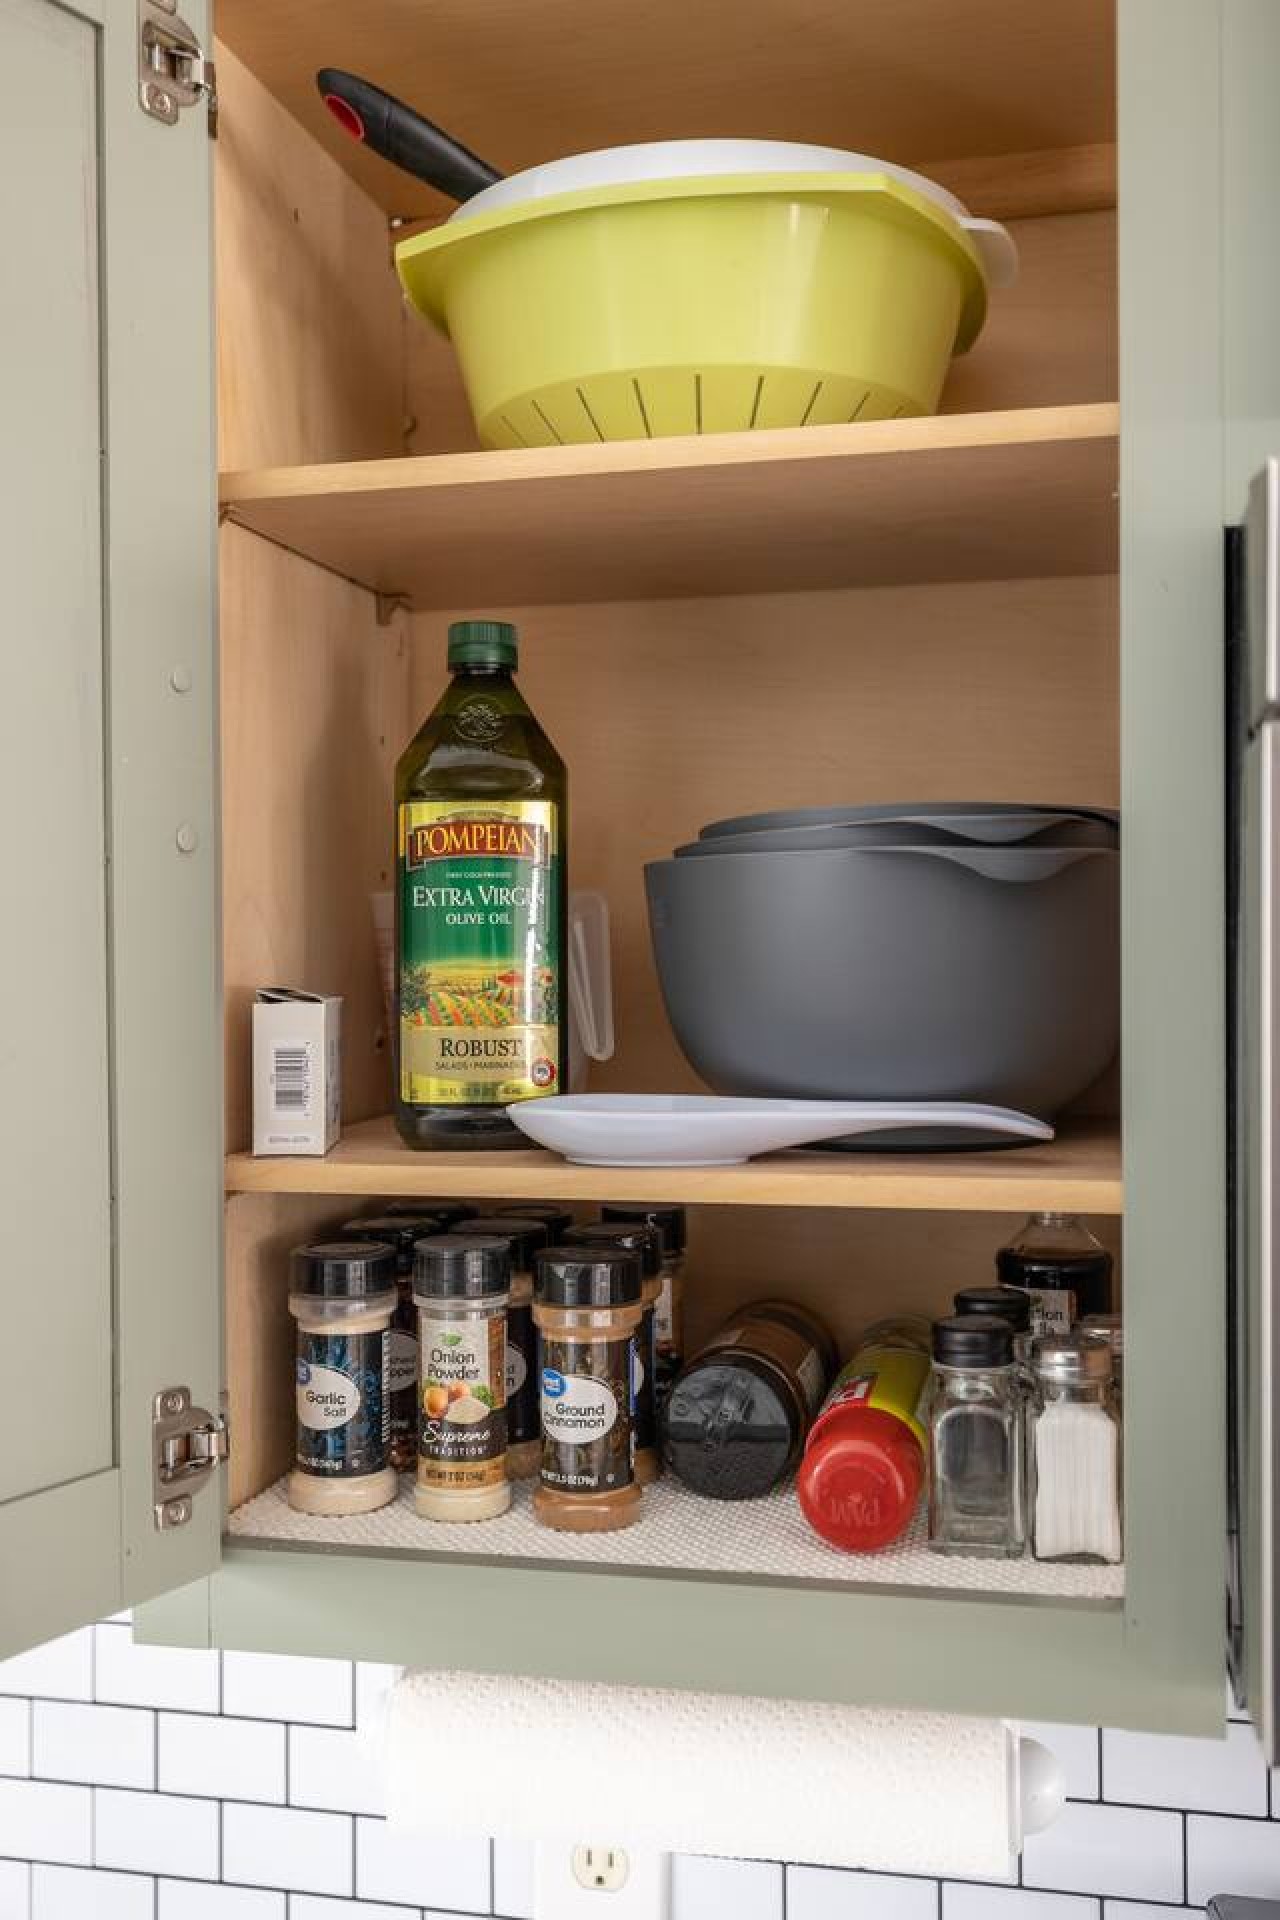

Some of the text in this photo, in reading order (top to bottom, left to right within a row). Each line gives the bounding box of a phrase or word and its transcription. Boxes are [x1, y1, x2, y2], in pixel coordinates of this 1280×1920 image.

[416, 823, 540, 857] POMPEIAN
[413, 886, 475, 907] EXTRA
[446, 913, 512, 925] OLIVE OIL
[440, 1038, 522, 1057] ROBUST
[431, 1348, 475, 1365] Onion
[427, 1364, 481, 1380] Powder
[305, 1390, 347, 1406] Garlic
[323, 1407, 347, 1417] Salt
[556, 1403, 606, 1417] Ground
